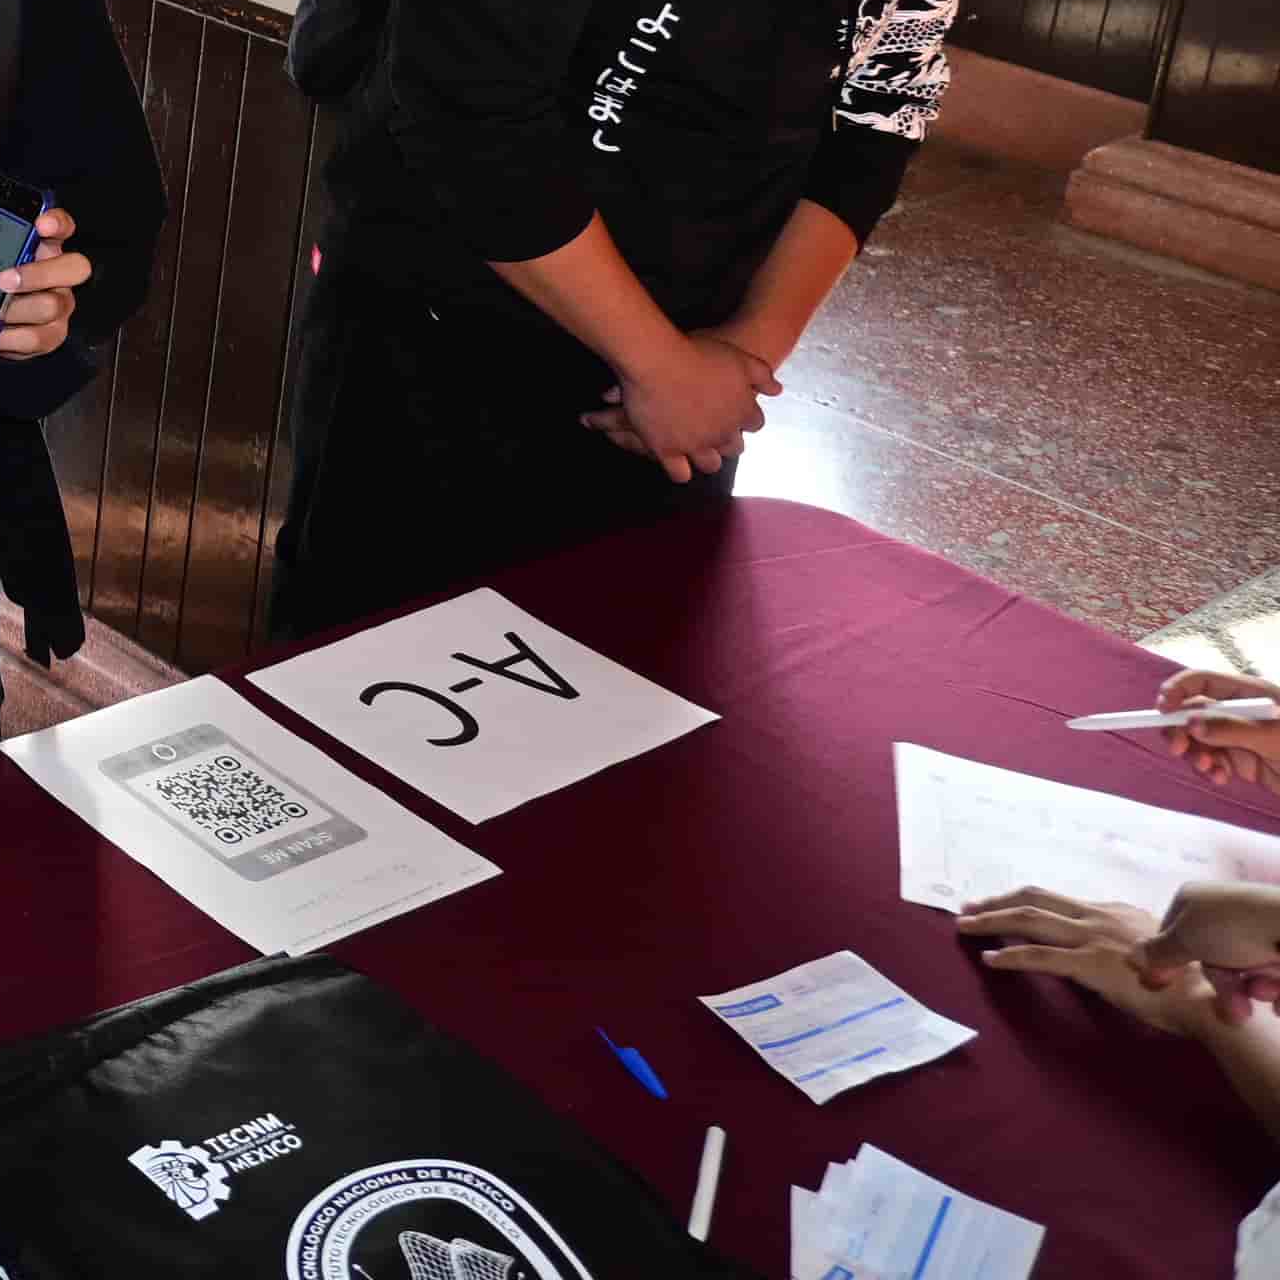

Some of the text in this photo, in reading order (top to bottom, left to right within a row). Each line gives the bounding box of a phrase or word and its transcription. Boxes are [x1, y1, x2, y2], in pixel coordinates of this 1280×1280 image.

[359, 631, 581, 747] A-C
[288, 831, 333, 857] SCAN
[203, 1112, 284, 1153] TECNM
[336, 1171, 415, 1208] NACIONAL
[416, 1170, 441, 1179] DE
[421, 1185, 443, 1195] DE
